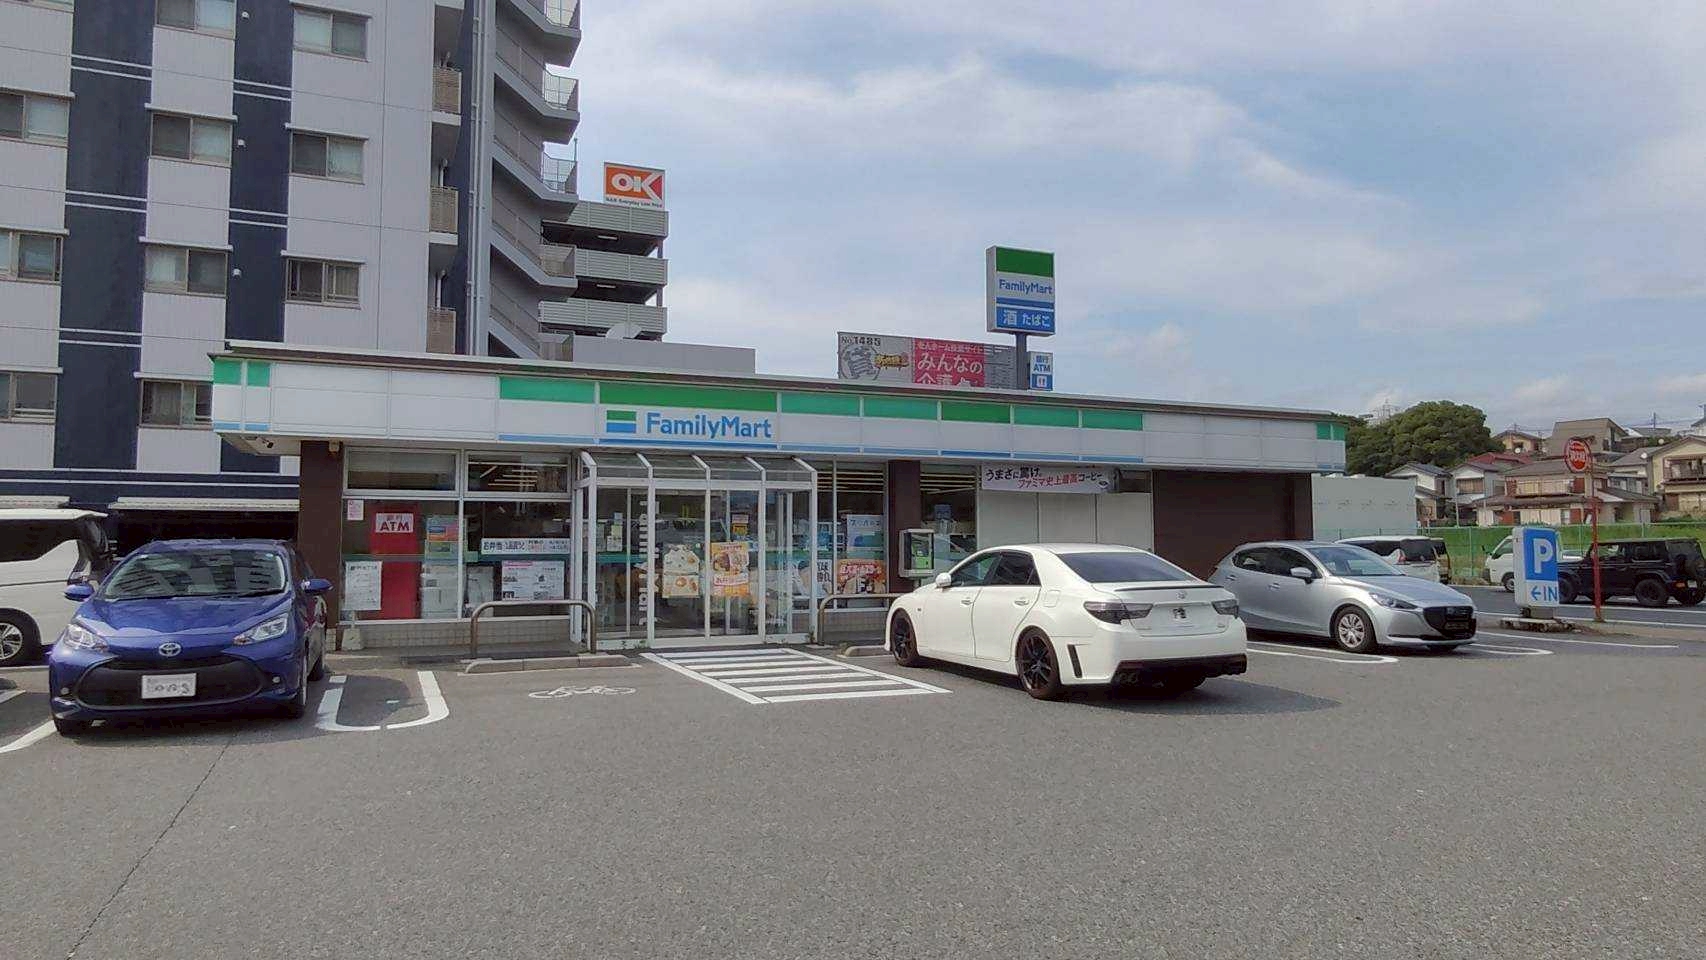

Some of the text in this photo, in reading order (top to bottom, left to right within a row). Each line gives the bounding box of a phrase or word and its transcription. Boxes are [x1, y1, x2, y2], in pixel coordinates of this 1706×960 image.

[611, 172, 663, 201] OK
[999, 279, 1052, 295] FamilyMart
[1001, 308, 1051, 328] 酒 たばこ
[917, 352, 983, 375] みんなの
[1034, 363, 1051, 373] ATM
[646, 412, 772, 439] FamilyMart
[380, 521, 410, 532] ATM
[1532, 537, 1554, 574] P
[1543, 585, 1558, 602] IN
